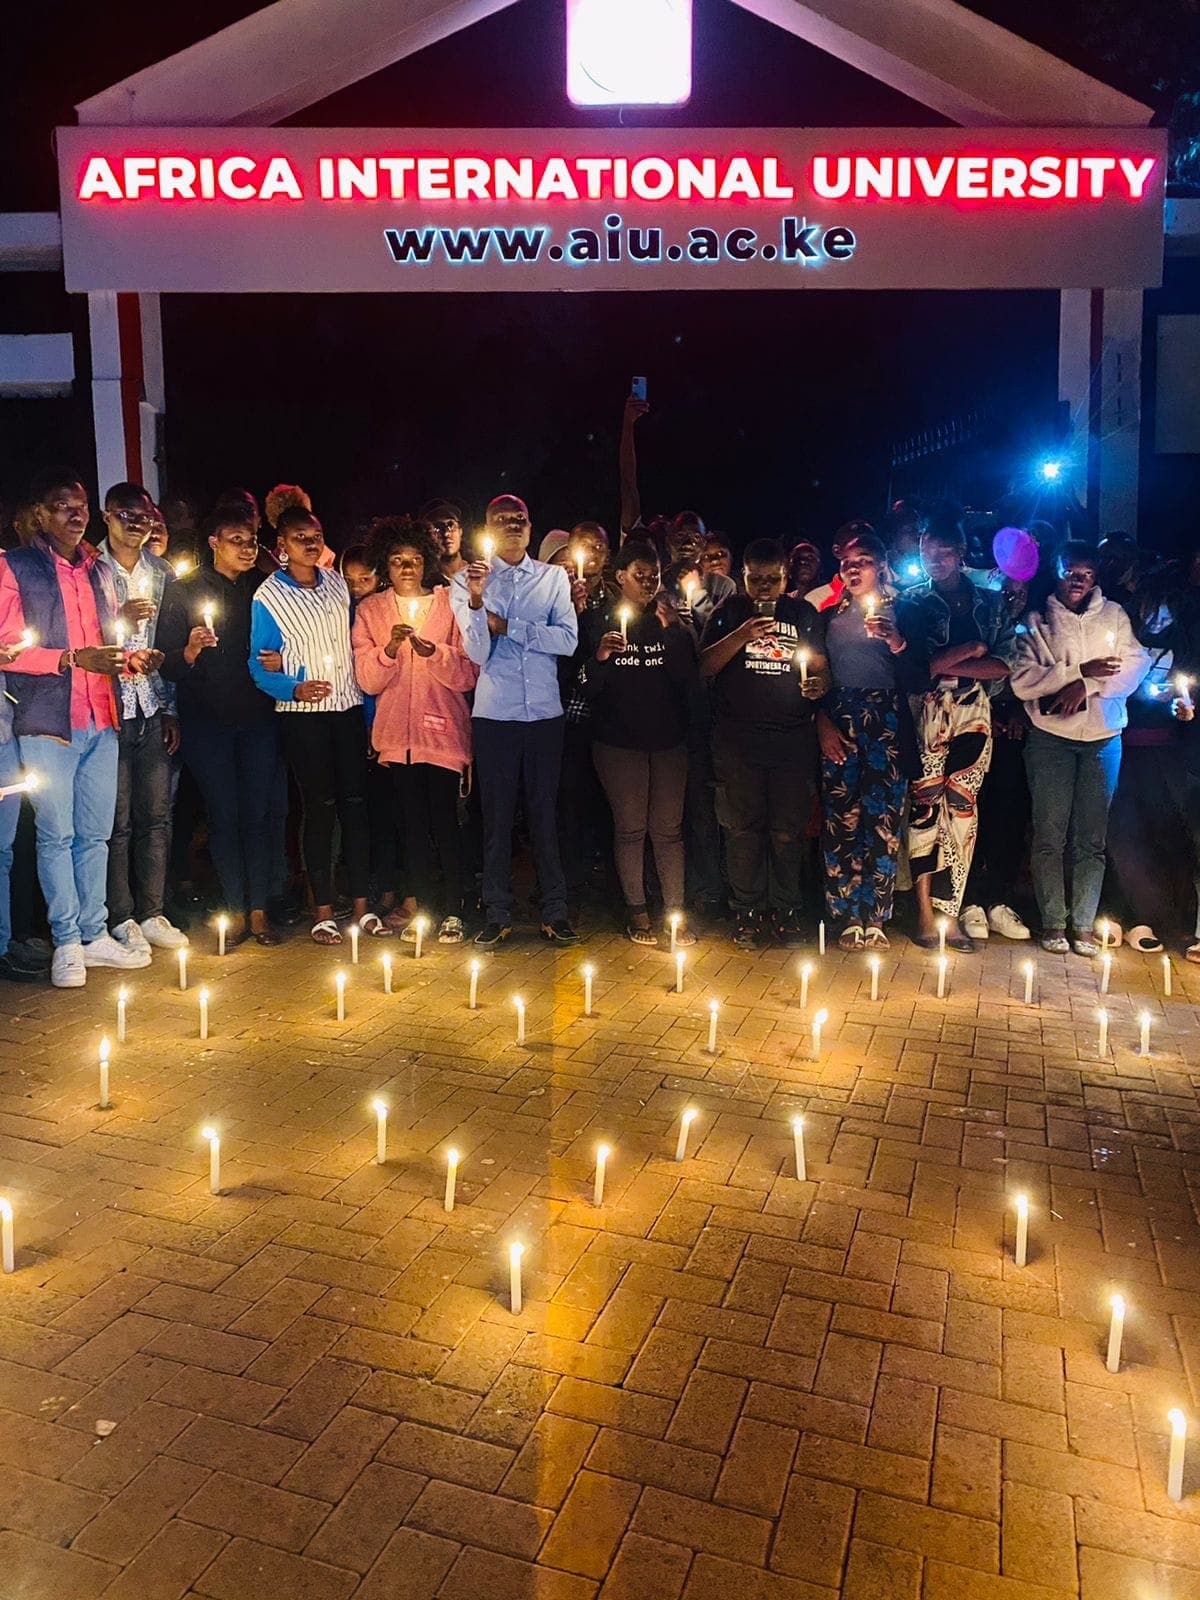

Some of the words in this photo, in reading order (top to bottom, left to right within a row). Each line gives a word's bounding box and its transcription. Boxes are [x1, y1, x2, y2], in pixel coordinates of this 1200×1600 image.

[79, 157, 302, 199] AFRICA
[319, 157, 793, 199] INTERNATIONAL
[812, 156, 1156, 198] UNIVERSITY
[384, 214, 855, 263] www.aiu.ac.ke
[615, 655, 640, 666] code
[645, 656, 664, 667] onc
